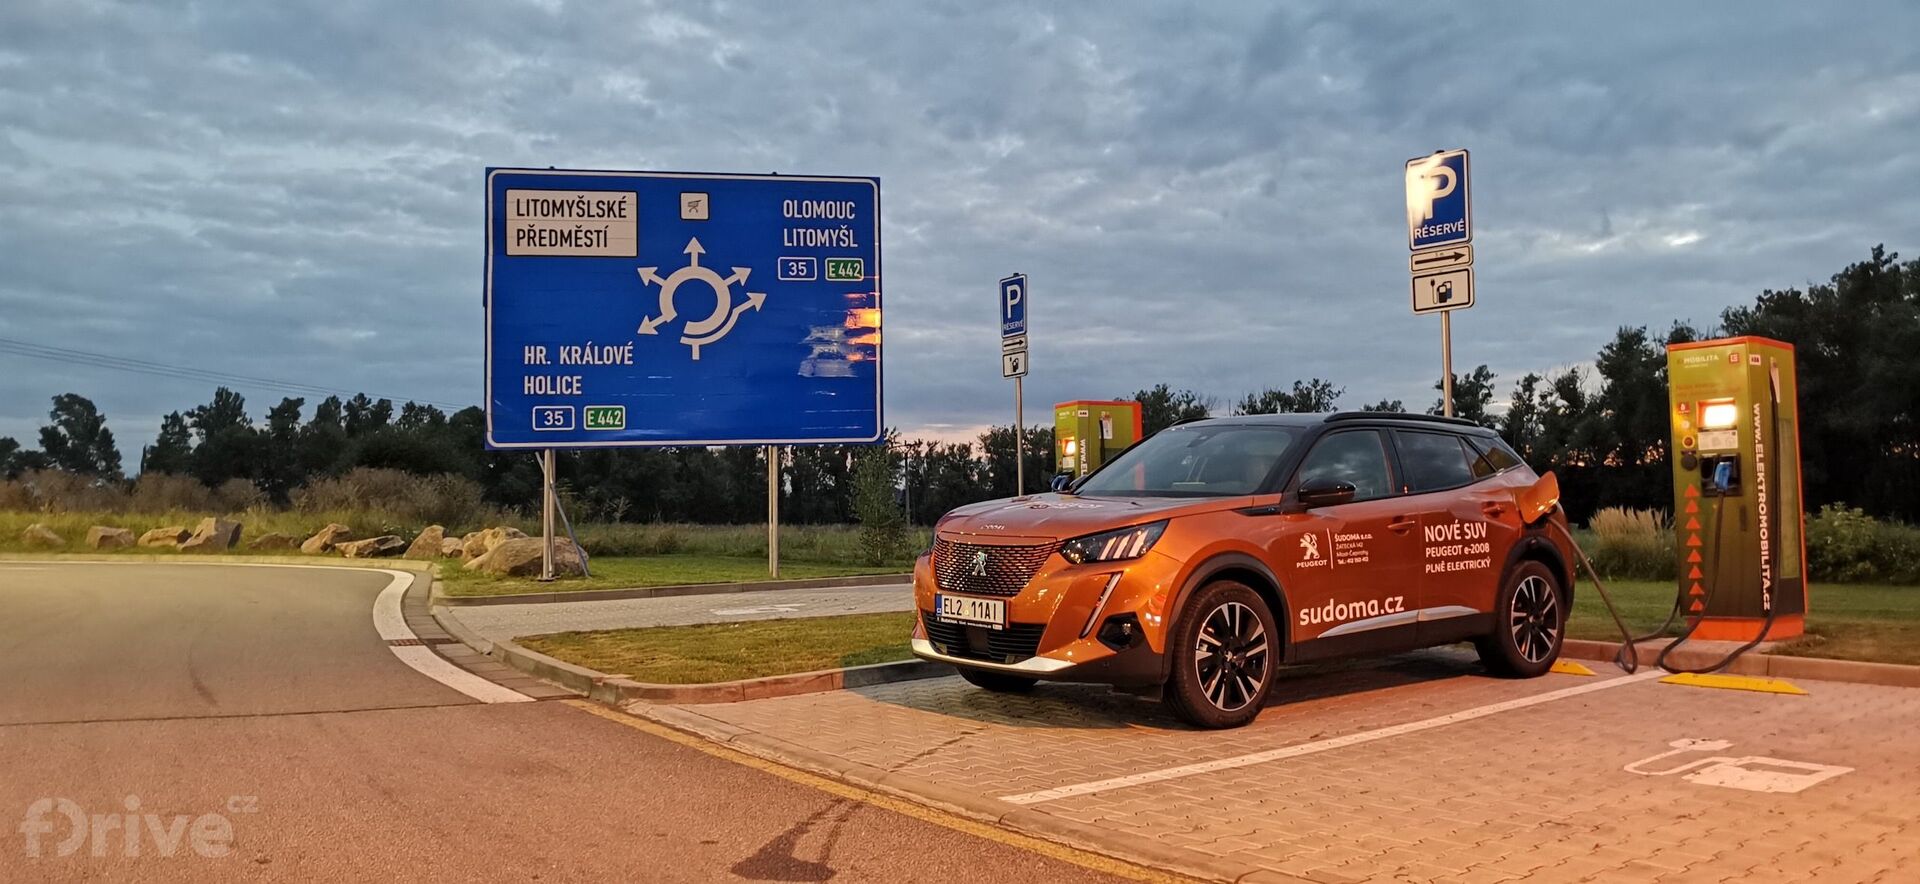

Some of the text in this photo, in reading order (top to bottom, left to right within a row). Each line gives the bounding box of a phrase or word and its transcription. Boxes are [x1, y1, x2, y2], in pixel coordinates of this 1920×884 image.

[1422, 165, 1457, 220] P
[516, 195, 627, 219] LITOMYŠLSKÉ
[783, 199, 856, 220] OLOMOUC
[516, 224, 609, 248] PŘEDMĚSTÍ
[783, 225, 859, 248] LITOMYŠL
[1414, 218, 1465, 240] RÉSERVÉ
[788, 261, 807, 277] 35
[828, 262, 861, 278] E 442
[1006, 284, 1022, 319] P
[524, 341, 634, 365] HR. KRÁLOVÉ
[524, 375, 583, 395] HOLICE
[543, 410, 564, 426] 35
[587, 410, 622, 425] E 442
[1424, 519, 1487, 542] NOVÉ SUV
[1425, 542, 1490, 558] PEUGEOT e-2008
[1296, 559, 1328, 568] PEUGEOT
[1425, 556, 1492, 573] PLNĚ ELEKTRICKÝ
[943, 597, 997, 621] EL2 11AI
[1299, 596, 1405, 626] sudoma.cz
